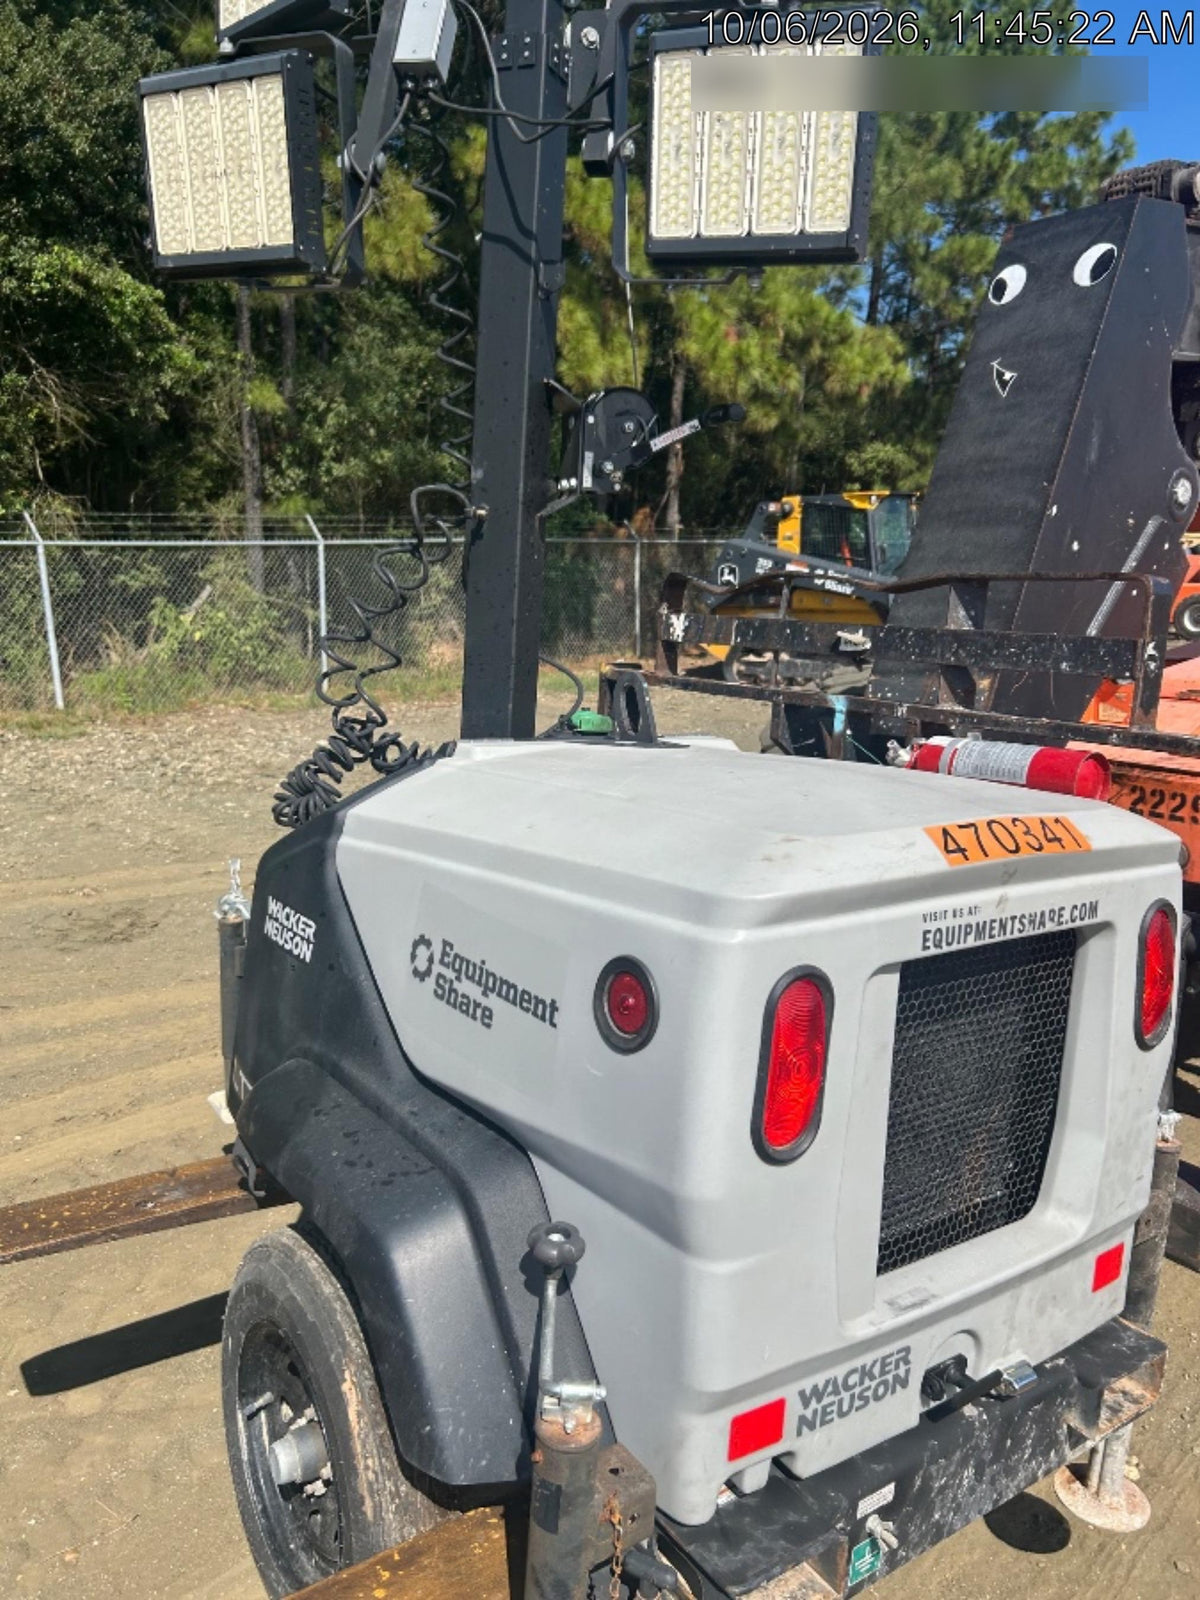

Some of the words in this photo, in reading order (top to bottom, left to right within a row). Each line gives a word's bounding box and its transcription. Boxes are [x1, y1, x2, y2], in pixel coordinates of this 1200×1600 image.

[942, 817, 1082, 861] 470341
[264, 915, 314, 963] NEUSON
[268, 895, 316, 943] WACKER
[921, 900, 1099, 951] EQUIPMENTSHARE.COM
[922, 909, 948, 924] VISIT
[952, 907, 964, 919] US
[433, 971, 494, 1030] Share
[438, 938, 560, 1029] Equipment
[796, 1366, 911, 1438] NEUSON
[797, 1345, 912, 1411] WACKER
